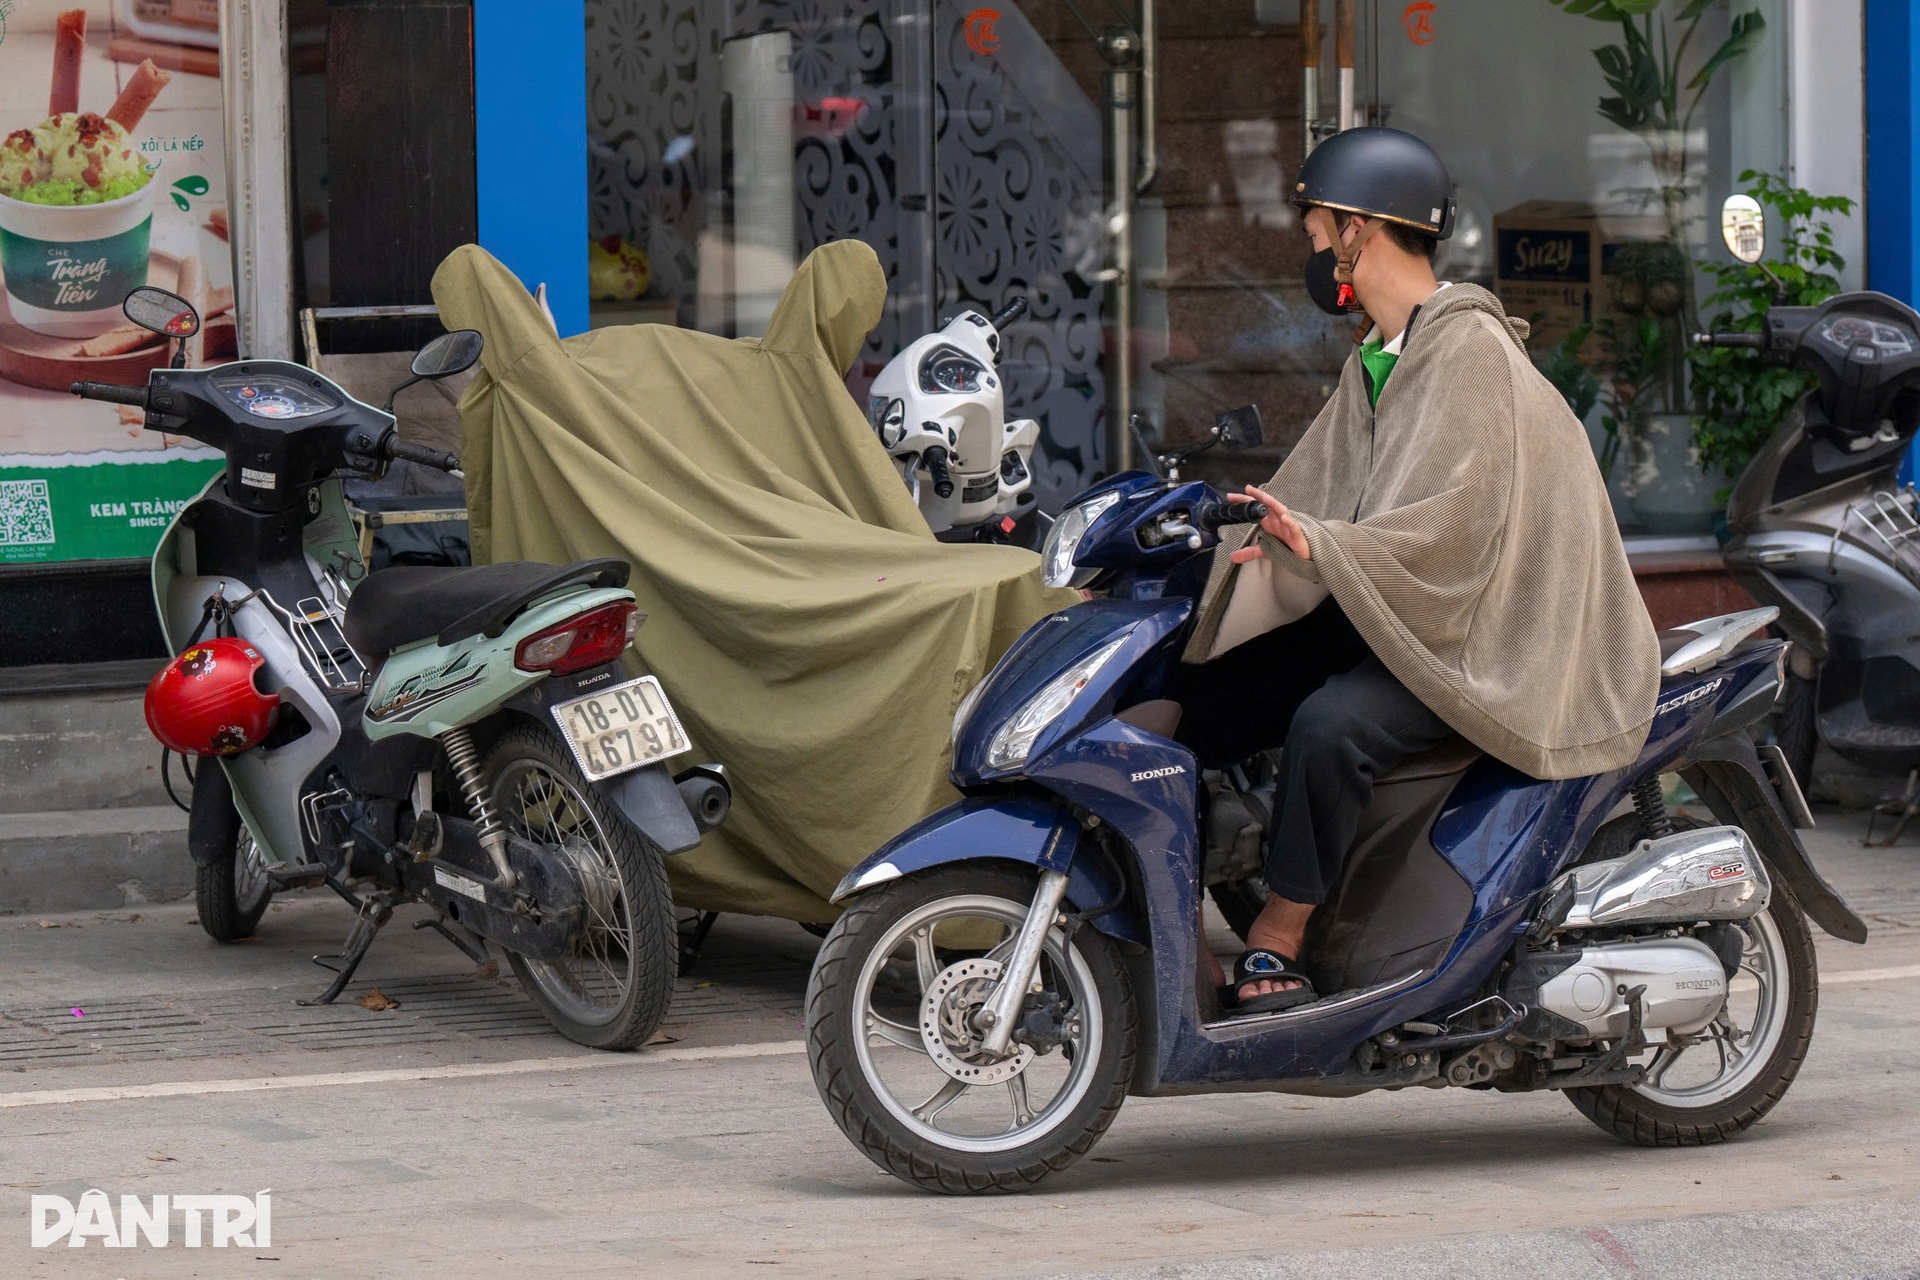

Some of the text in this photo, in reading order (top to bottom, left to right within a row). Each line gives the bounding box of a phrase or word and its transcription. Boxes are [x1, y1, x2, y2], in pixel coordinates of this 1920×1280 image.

[141, 134, 204, 151] XÔI LÁ NẾP
[46, 258, 111, 283] Tràng
[54, 281, 98, 305] Tiền
[90, 503, 127, 517] KEM
[129, 516, 166, 528] SINCE
[577, 672, 612, 688] HONDA
[573, 686, 654, 735] 18-D1
[1131, 765, 1186, 782] HONDA
[1675, 979, 1721, 989] HONDA
